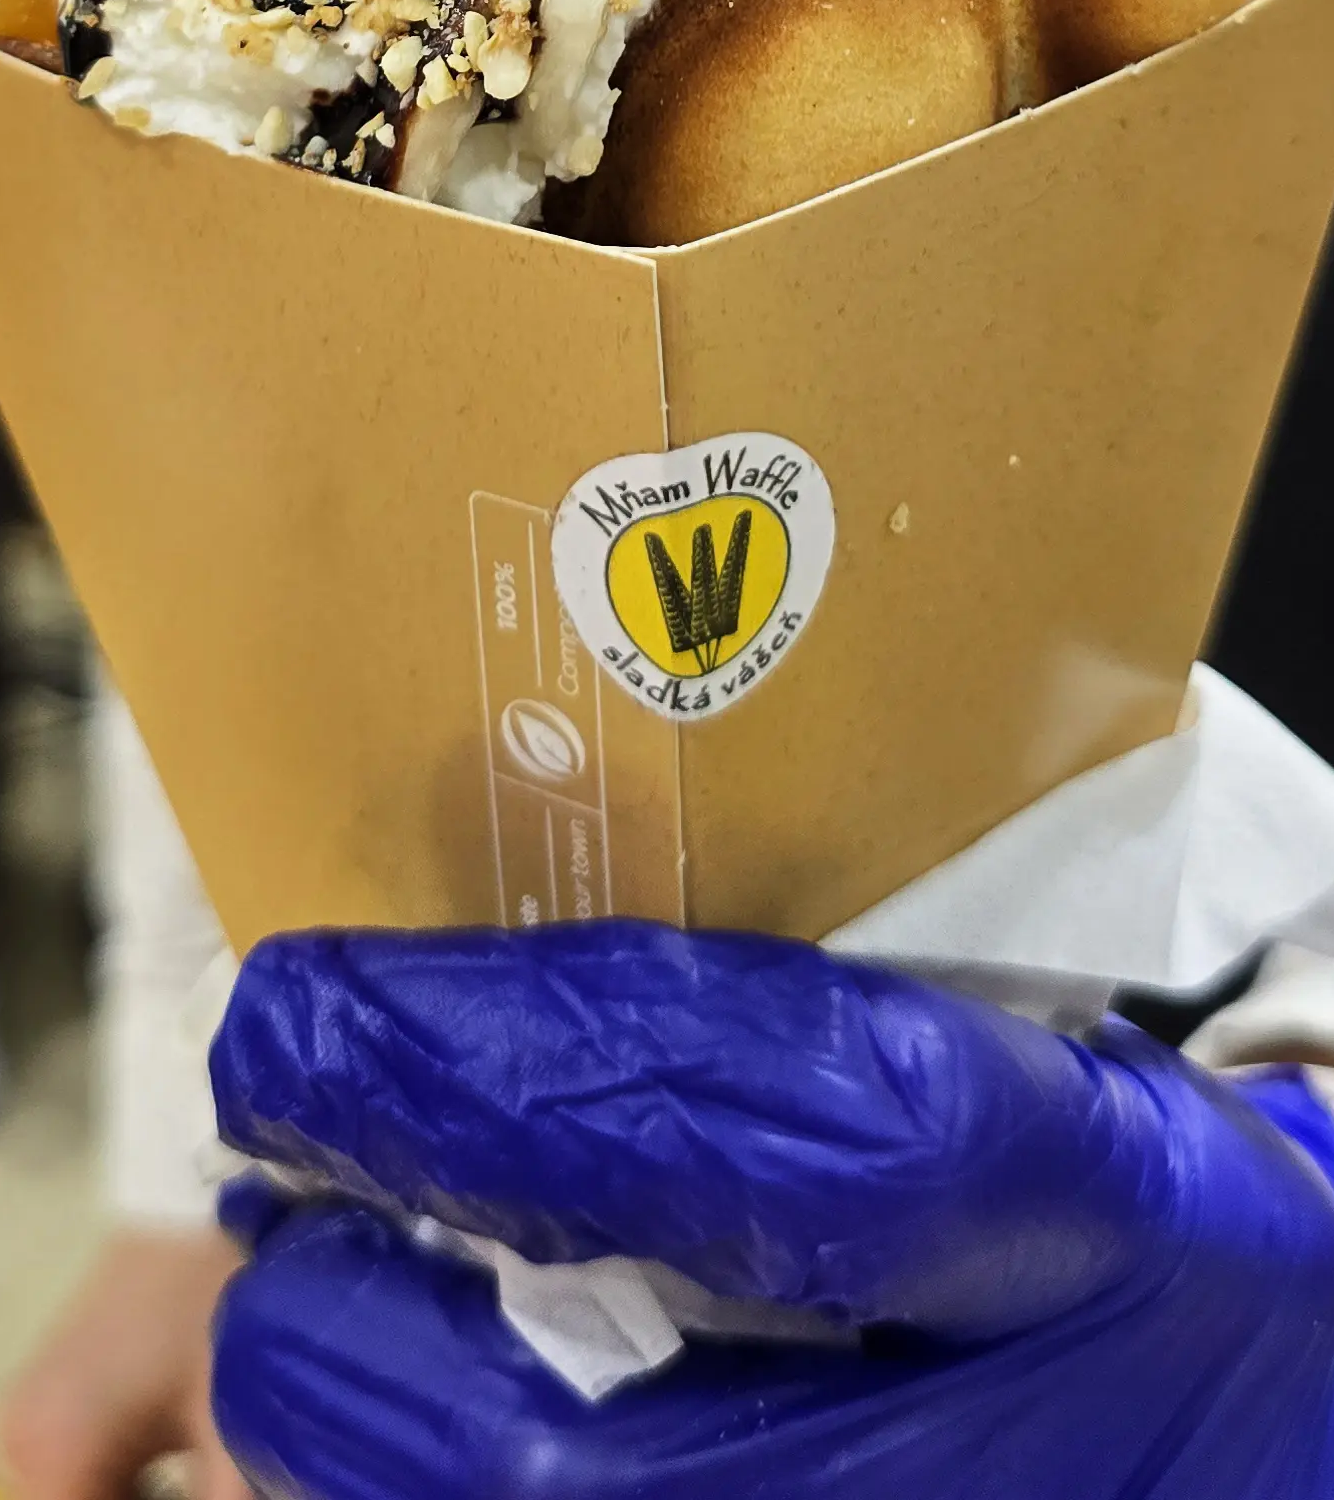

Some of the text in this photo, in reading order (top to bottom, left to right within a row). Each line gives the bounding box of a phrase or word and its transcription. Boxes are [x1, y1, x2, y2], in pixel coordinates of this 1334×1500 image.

[578, 445, 802, 537] Mňam Waffle
[496, 561, 518, 632] 100%
[602, 610, 803, 713] sladká vášeň
